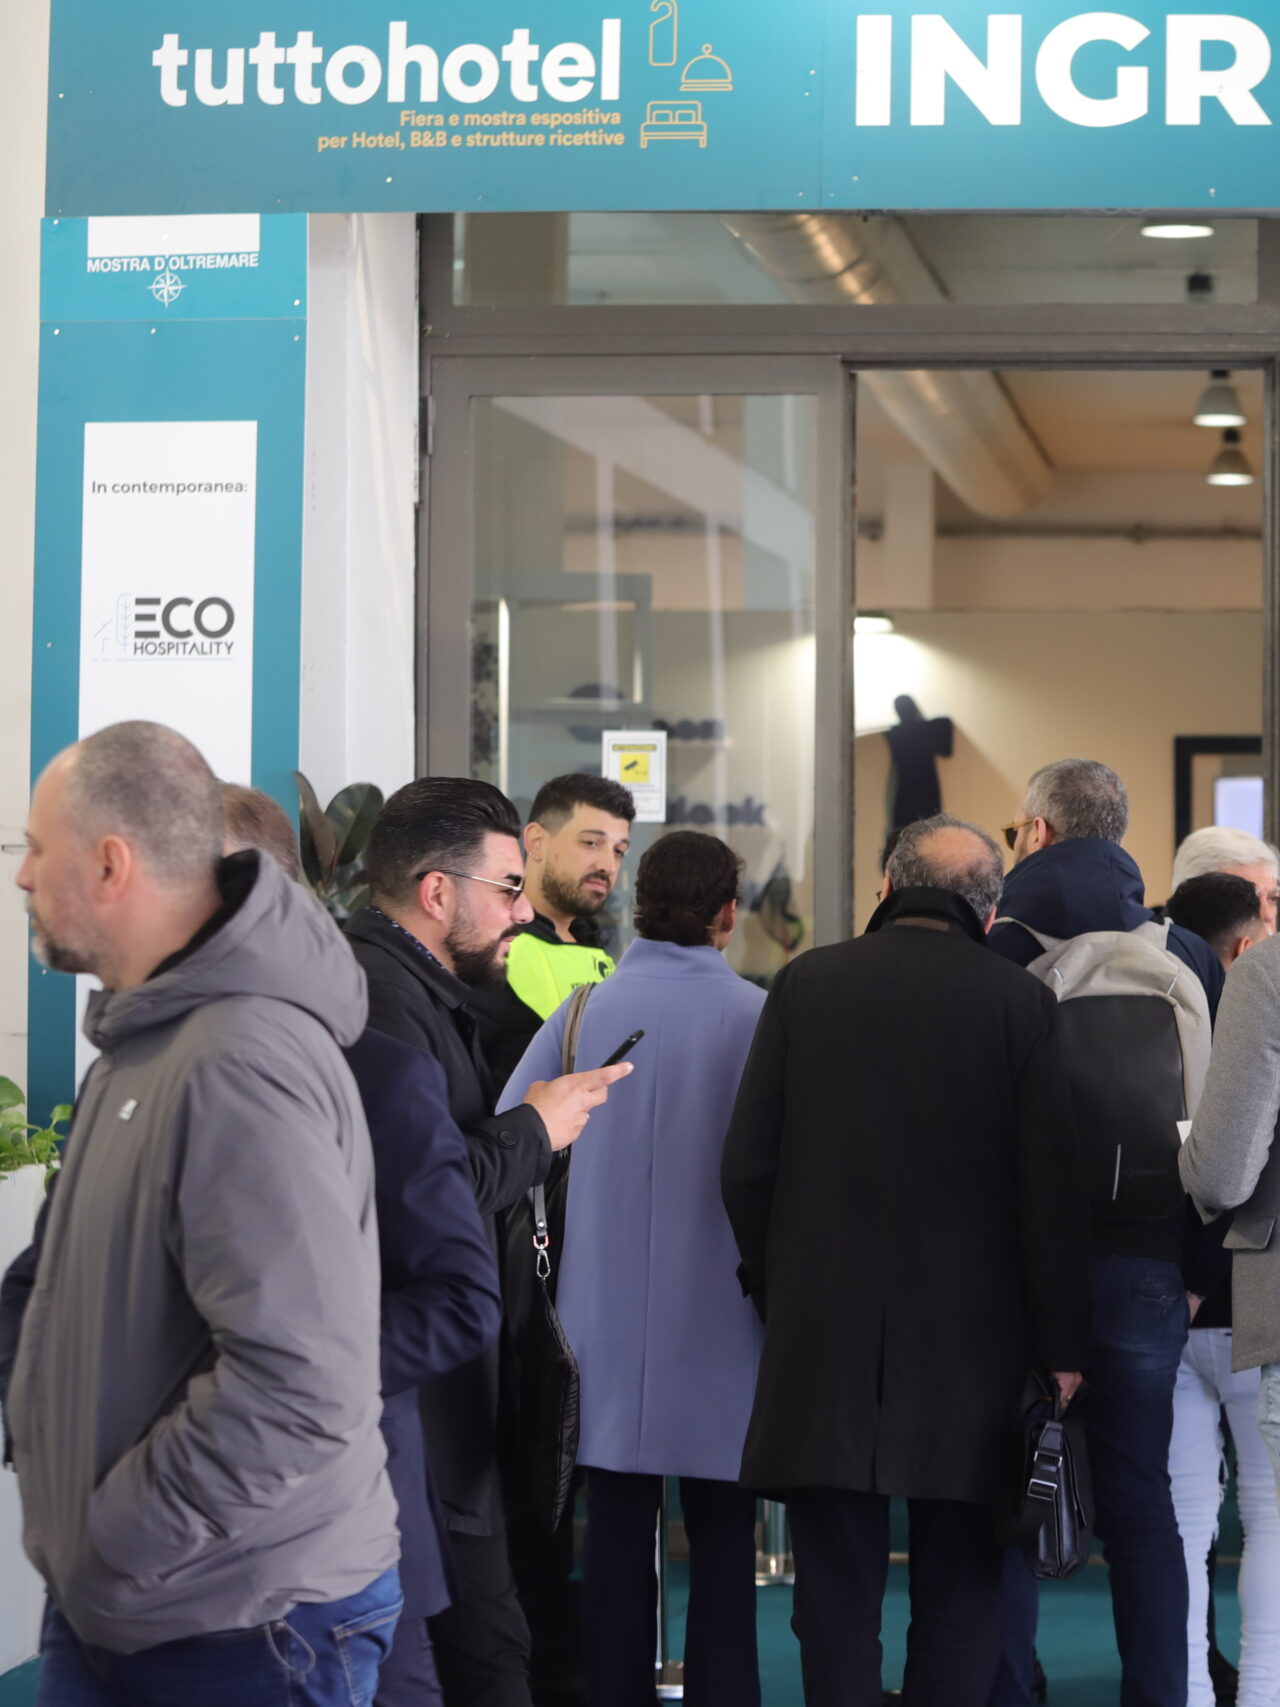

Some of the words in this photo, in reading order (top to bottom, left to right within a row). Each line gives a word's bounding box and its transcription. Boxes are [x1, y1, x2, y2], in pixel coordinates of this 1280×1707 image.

[152, 18, 621, 106] tuttohotel
[400, 110, 444, 126] Fiera
[448, 113, 461, 126] e
[463, 110, 526, 126] mostra
[530, 108, 621, 128] espositiva
[317, 135, 348, 151] per
[352, 131, 405, 150] Hotel,
[410, 131, 447, 147] B&B
[451, 134, 462, 147] e
[466, 130, 545, 147] strutture
[549, 129, 625, 146] ricettive
[87, 257, 150, 273] MOSTRA
[92, 481, 107, 493] In
[112, 481, 248, 496] contemporanea:
[134, 597, 235, 639] ECO
[133, 641, 234, 656] HOSPITALITY
